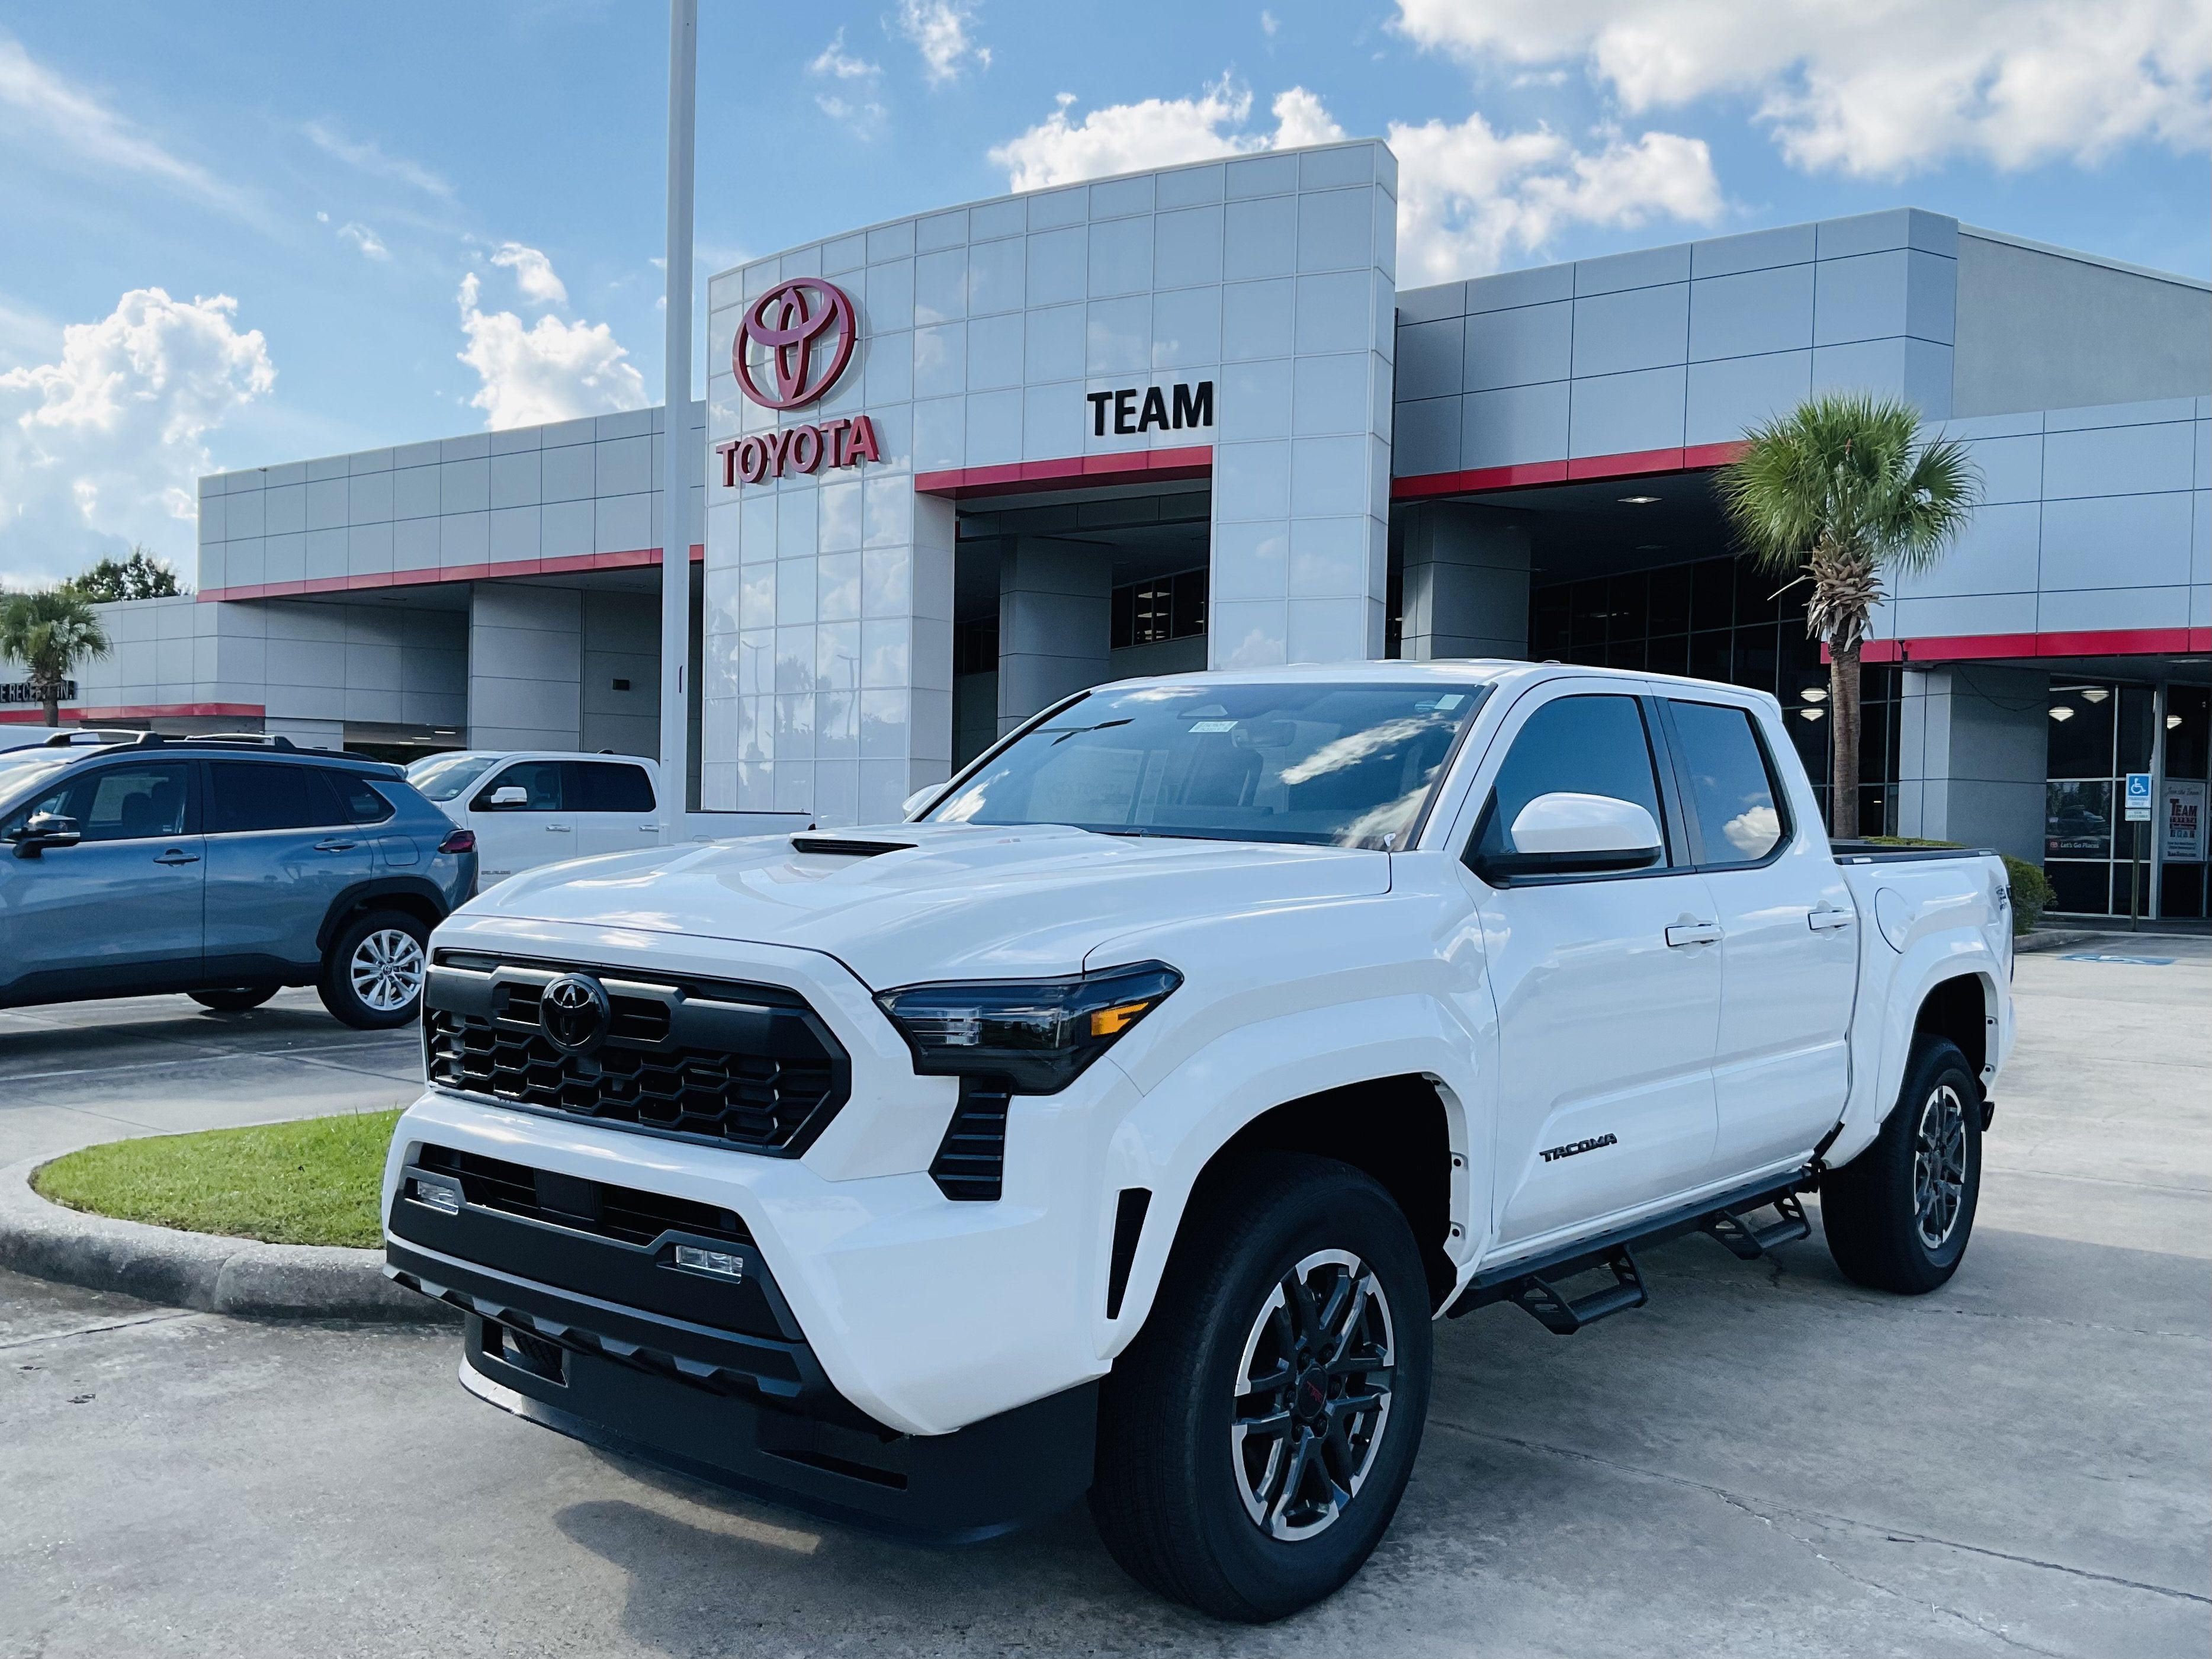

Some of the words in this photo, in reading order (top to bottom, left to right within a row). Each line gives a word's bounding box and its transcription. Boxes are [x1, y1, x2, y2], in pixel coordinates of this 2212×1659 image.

[1087, 381, 1213, 436] TEAM
[716, 415, 880, 487] TOYOTA
[1539, 1132, 1617, 1162] TACOMA
